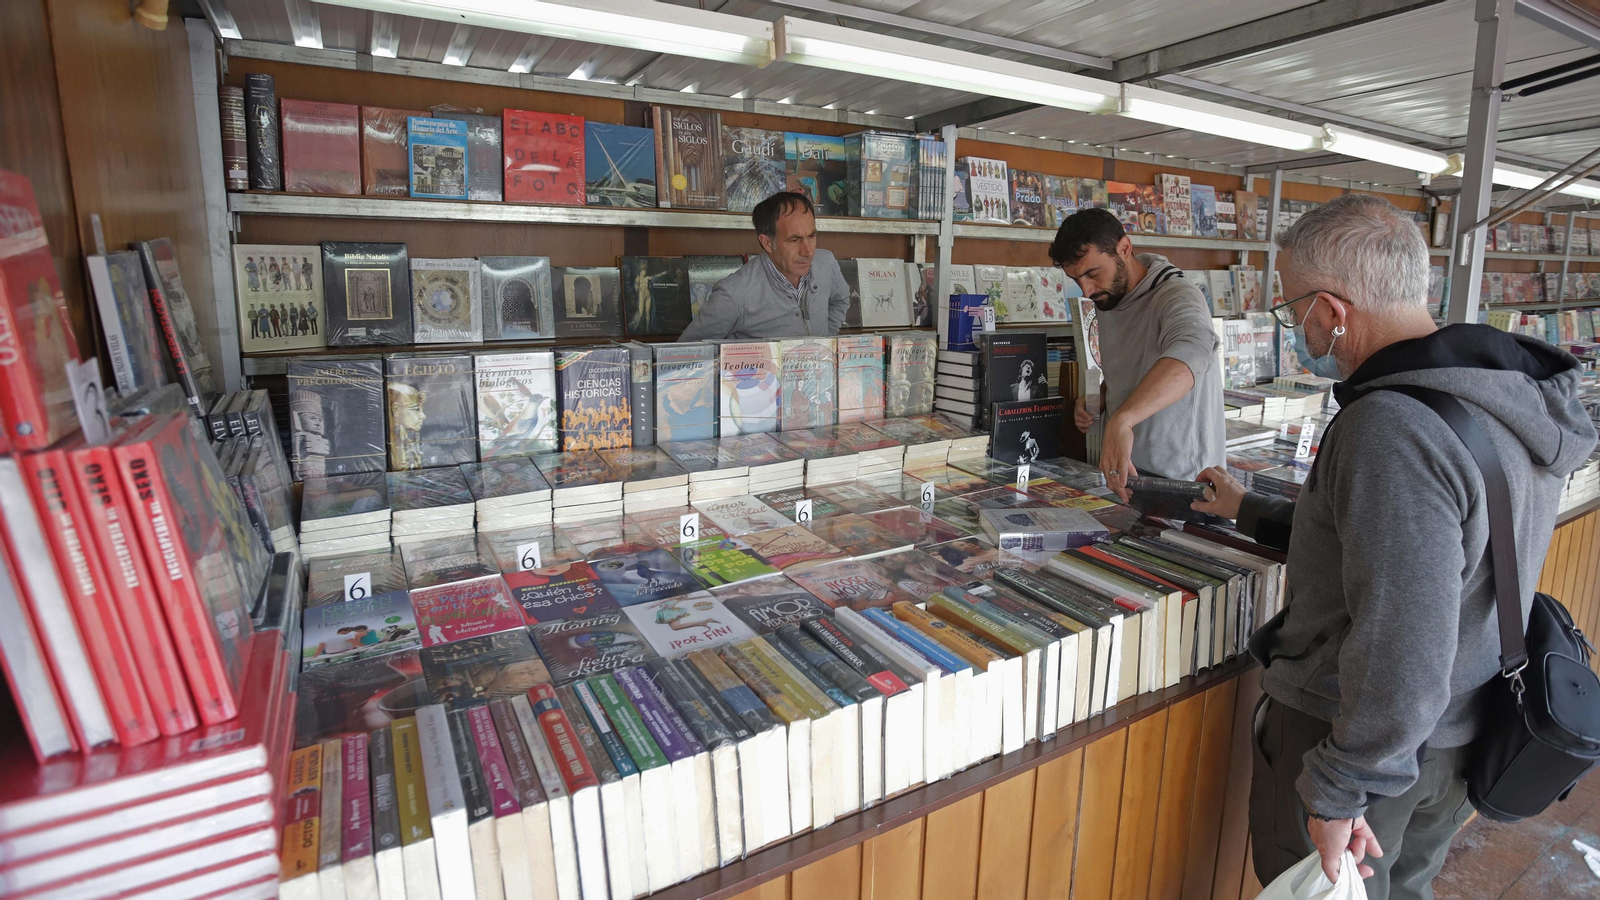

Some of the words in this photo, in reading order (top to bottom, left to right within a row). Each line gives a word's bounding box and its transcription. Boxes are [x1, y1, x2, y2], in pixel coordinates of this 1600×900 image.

[510, 118, 534, 137] EL
[541, 121, 580, 138] ABC
[673, 121, 703, 132] SIGLOS
[678, 134, 708, 145] SIGLOS
[876, 141, 903, 150] MUSEOS
[732, 139, 775, 158] Gaudí
[802, 144, 830, 160] Dalí
[514, 148, 540, 164] DE
[552, 149, 577, 169] LA
[513, 172, 578, 196] FOTO
[976, 182, 1004, 193] VESTIDO
[1015, 192, 1041, 204] Prado
[344, 253, 364, 261] Biblia
[364, 253, 390, 261] Natalis
[868, 269, 897, 279] SOLANA
[1237, 332, 1252, 345] 600
[841, 352, 875, 361] Física
[992, 346, 1029, 355] MORENTE
[313, 367, 359, 378] AMÉRICA
[404, 364, 456, 376] EGIPTO
[478, 367, 533, 379] Términos
[588, 366, 621, 374] DICCIONARIO
[660, 361, 703, 371] Geografía
[723, 361, 765, 371] Teología
[296, 376, 376, 387] PRECOLOMBINA
[478, 375, 533, 389] biológicos
[576, 377, 622, 390] CIENCIAS
[998, 406, 1033, 418] CABALLEROS
[1033, 403, 1063, 414] FLAMENCOS
[1298, 440, 1309, 457] 5
[84, 463, 112, 507] SEXO
[129, 457, 157, 501] SEXO
[149, 500, 161, 515] DEL
[706, 500, 748, 513] amor
[721, 505, 768, 520] cristal
[107, 521, 140, 589] ENCICLOPEDIA
[152, 516, 183, 581] ENCICLOPEDIA
[726, 557, 758, 568] POR
[350, 577, 366, 600] 6
[521, 584, 547, 592] MHAIRI
[549, 577, 590, 588] MCFARLANE
[650, 582, 684, 596] pecado
[824, 575, 869, 590] ACOSO
[829, 580, 886, 599] MORTAL
[520, 586, 572, 602] ¿Quién
[576, 582, 597, 592] es
[522, 599, 553, 610] esa
[554, 587, 603, 605] chica?
[430, 604, 449, 613] en
[471, 597, 490, 606] te
[747, 597, 818, 622] AMOR
[454, 623, 496, 635] McFarlane
[460, 619, 487, 628] Mhairi
[543, 613, 622, 636] Moning
[703, 625, 734, 641] FIN!
[568, 653, 645, 679] oscura
[578, 651, 631, 672] fiebre
[292, 754, 306, 785] DANIEL
[307, 750, 320, 782] ESTULIN
